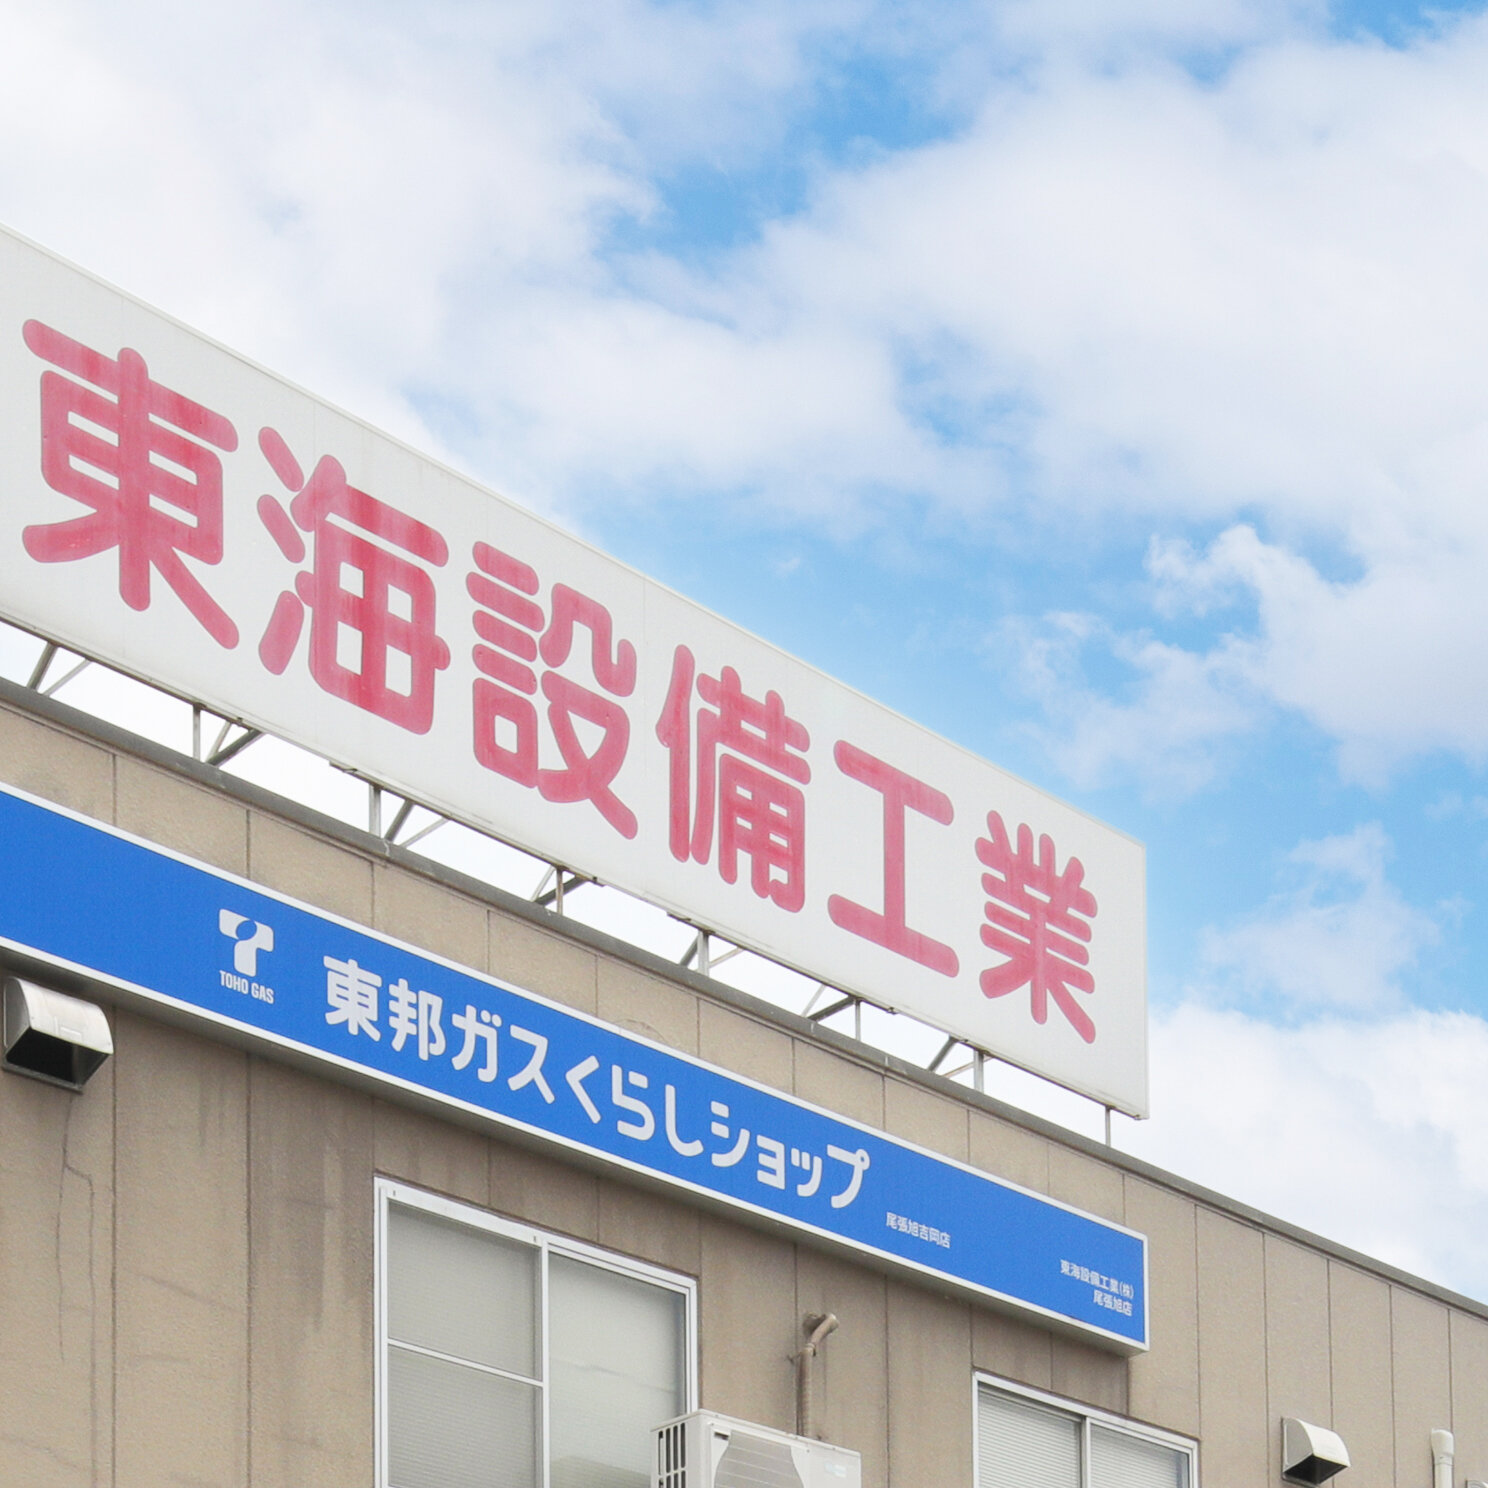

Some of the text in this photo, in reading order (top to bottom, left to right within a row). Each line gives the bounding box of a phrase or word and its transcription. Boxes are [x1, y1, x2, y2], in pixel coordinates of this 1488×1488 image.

[21, 318, 1098, 1045] 東海設備工業
[219, 969, 275, 1005] TOHO GAS
[323, 955, 871, 1209] 東邦ガスくらしショップ
[885, 1211, 952, 1249] 尾張旭吉岡店
[1092, 1288, 1134, 1318] 尾張旭店
